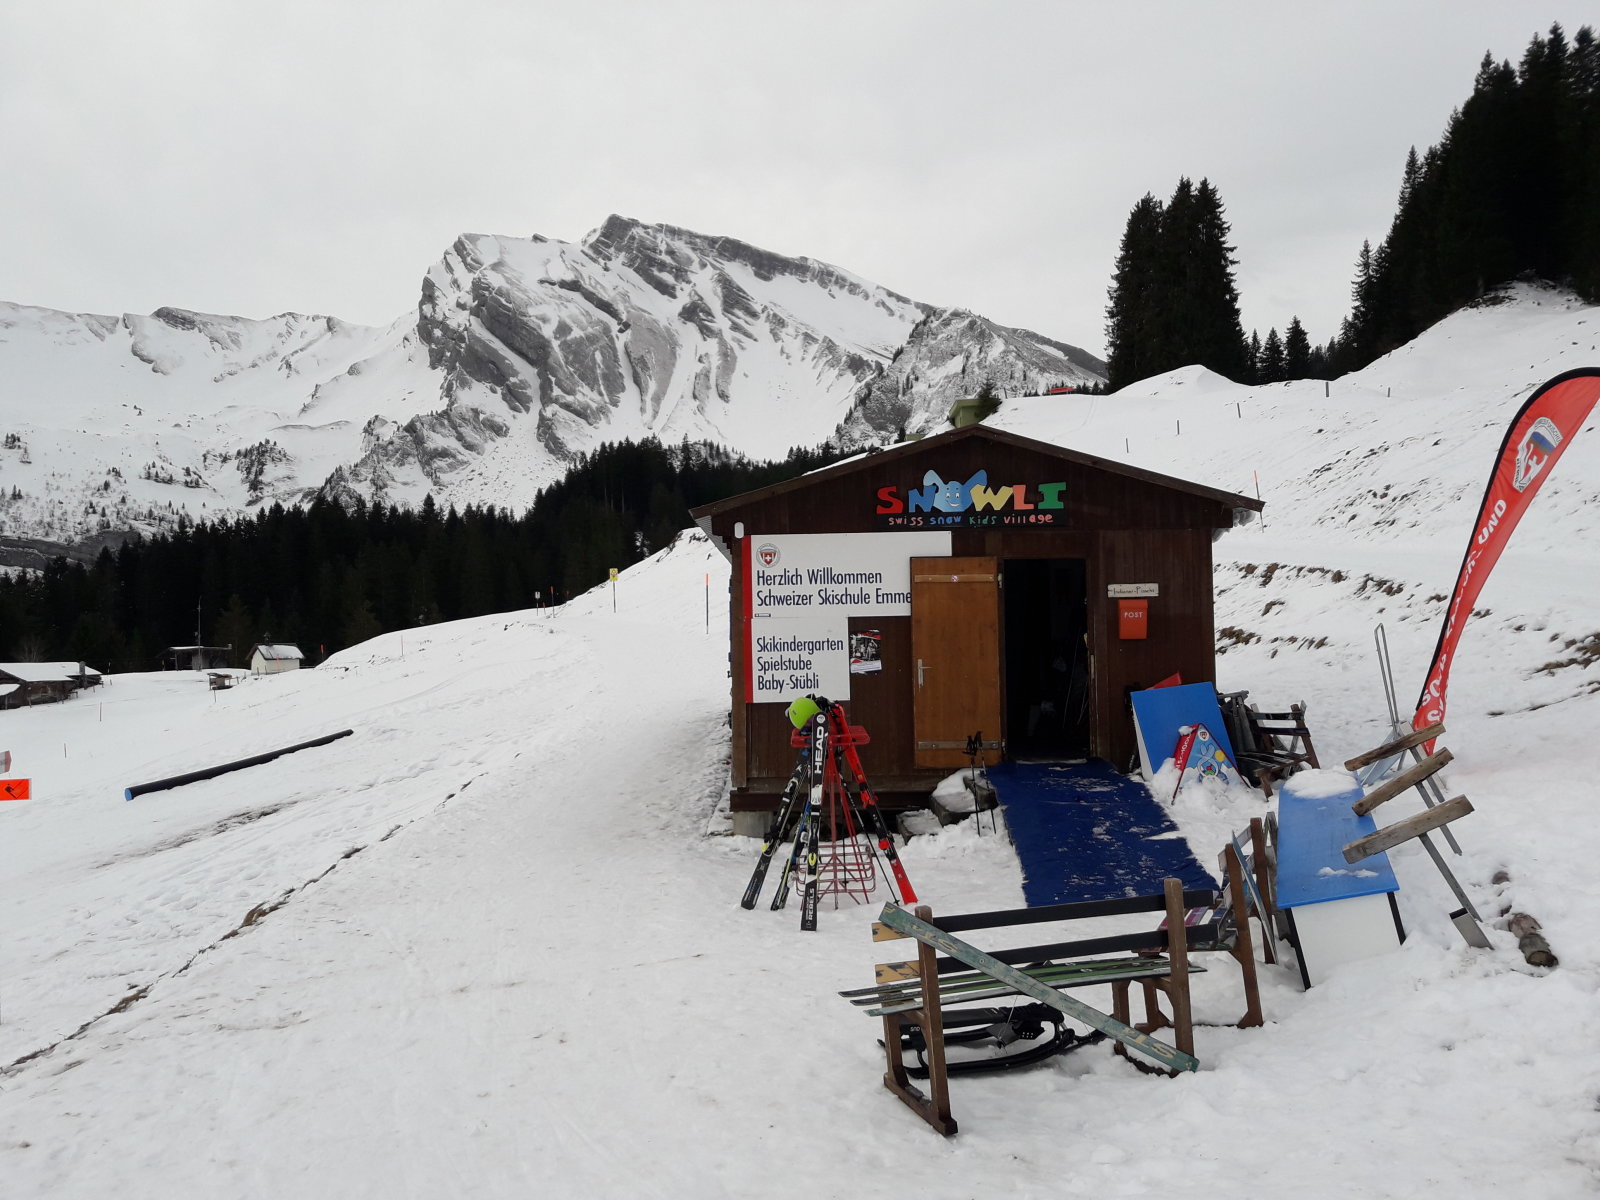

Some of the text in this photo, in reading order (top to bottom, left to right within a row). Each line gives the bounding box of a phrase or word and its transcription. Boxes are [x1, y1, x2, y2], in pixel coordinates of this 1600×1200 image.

[1478, 499, 1507, 544] UND
[756, 567, 882, 586] Herzlich Willkommen
[756, 588, 813, 607] Schweizer
[817, 586, 871, 606] Skischule
[1124, 611, 1144, 619] POST
[756, 635, 844, 655] Skikindergarten
[757, 653, 812, 675] Spielstube
[814, 726, 825, 774] HEAD
